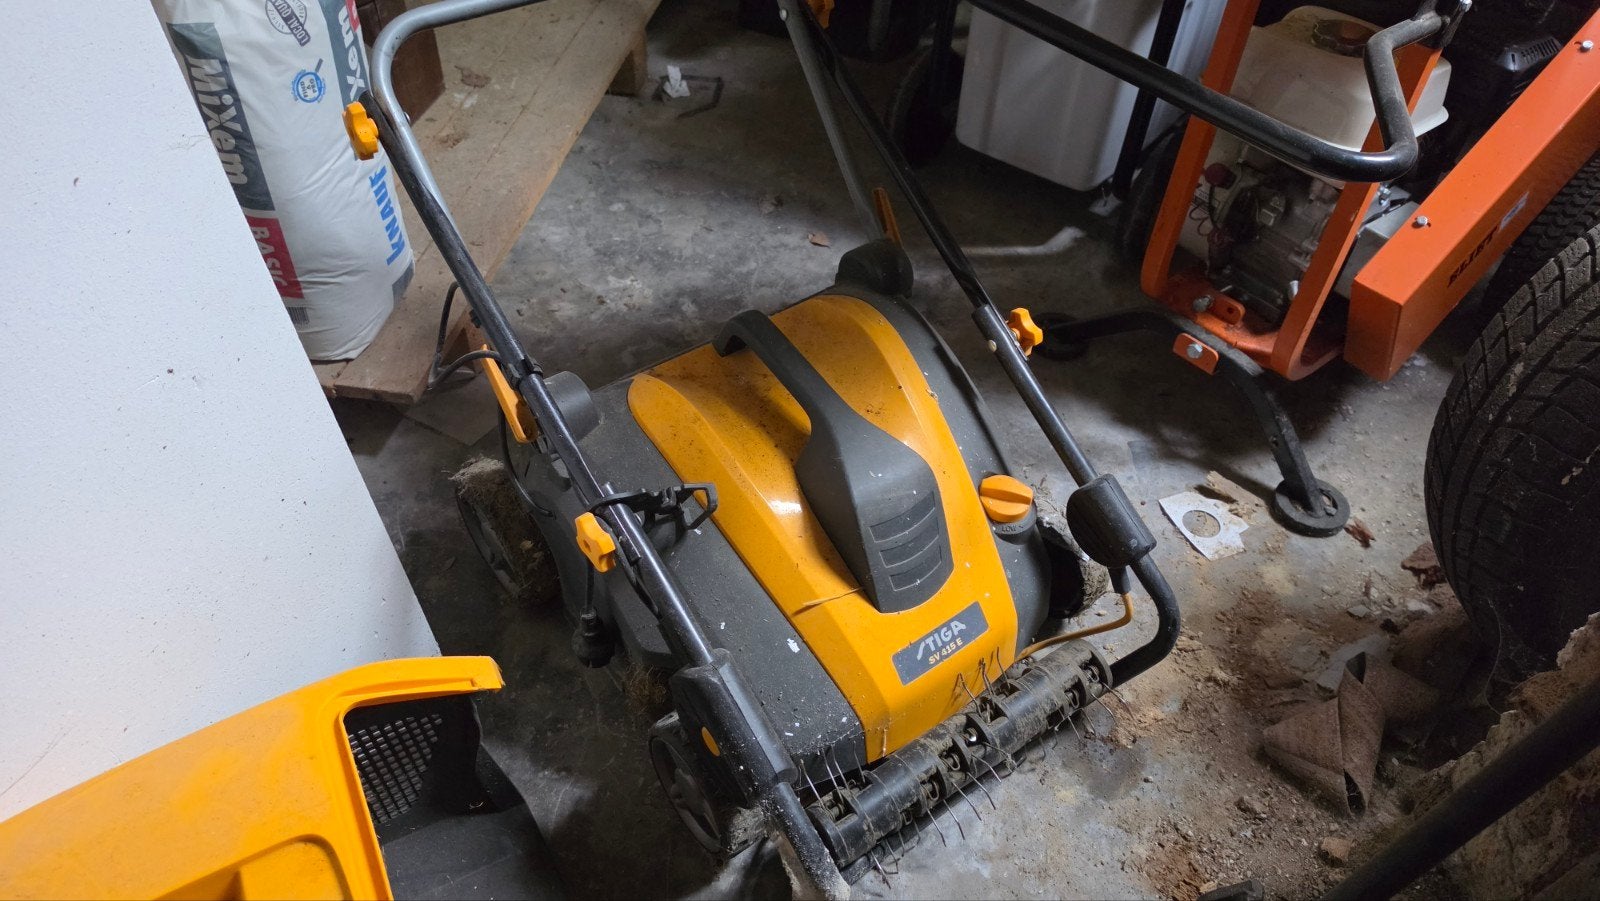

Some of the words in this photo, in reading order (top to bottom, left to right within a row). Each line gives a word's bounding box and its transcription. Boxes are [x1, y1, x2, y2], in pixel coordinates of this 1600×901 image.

[271, 0, 291, 17] QUA
[288, 16, 310, 45] LOCAL
[309, 78, 317, 93] PRO
[369, 165, 406, 266] KNAUF
[916, 620, 967, 661] STIGA
[928, 651, 940, 665] SV
[941, 641, 957, 656] 415
[955, 637, 963, 647] E
